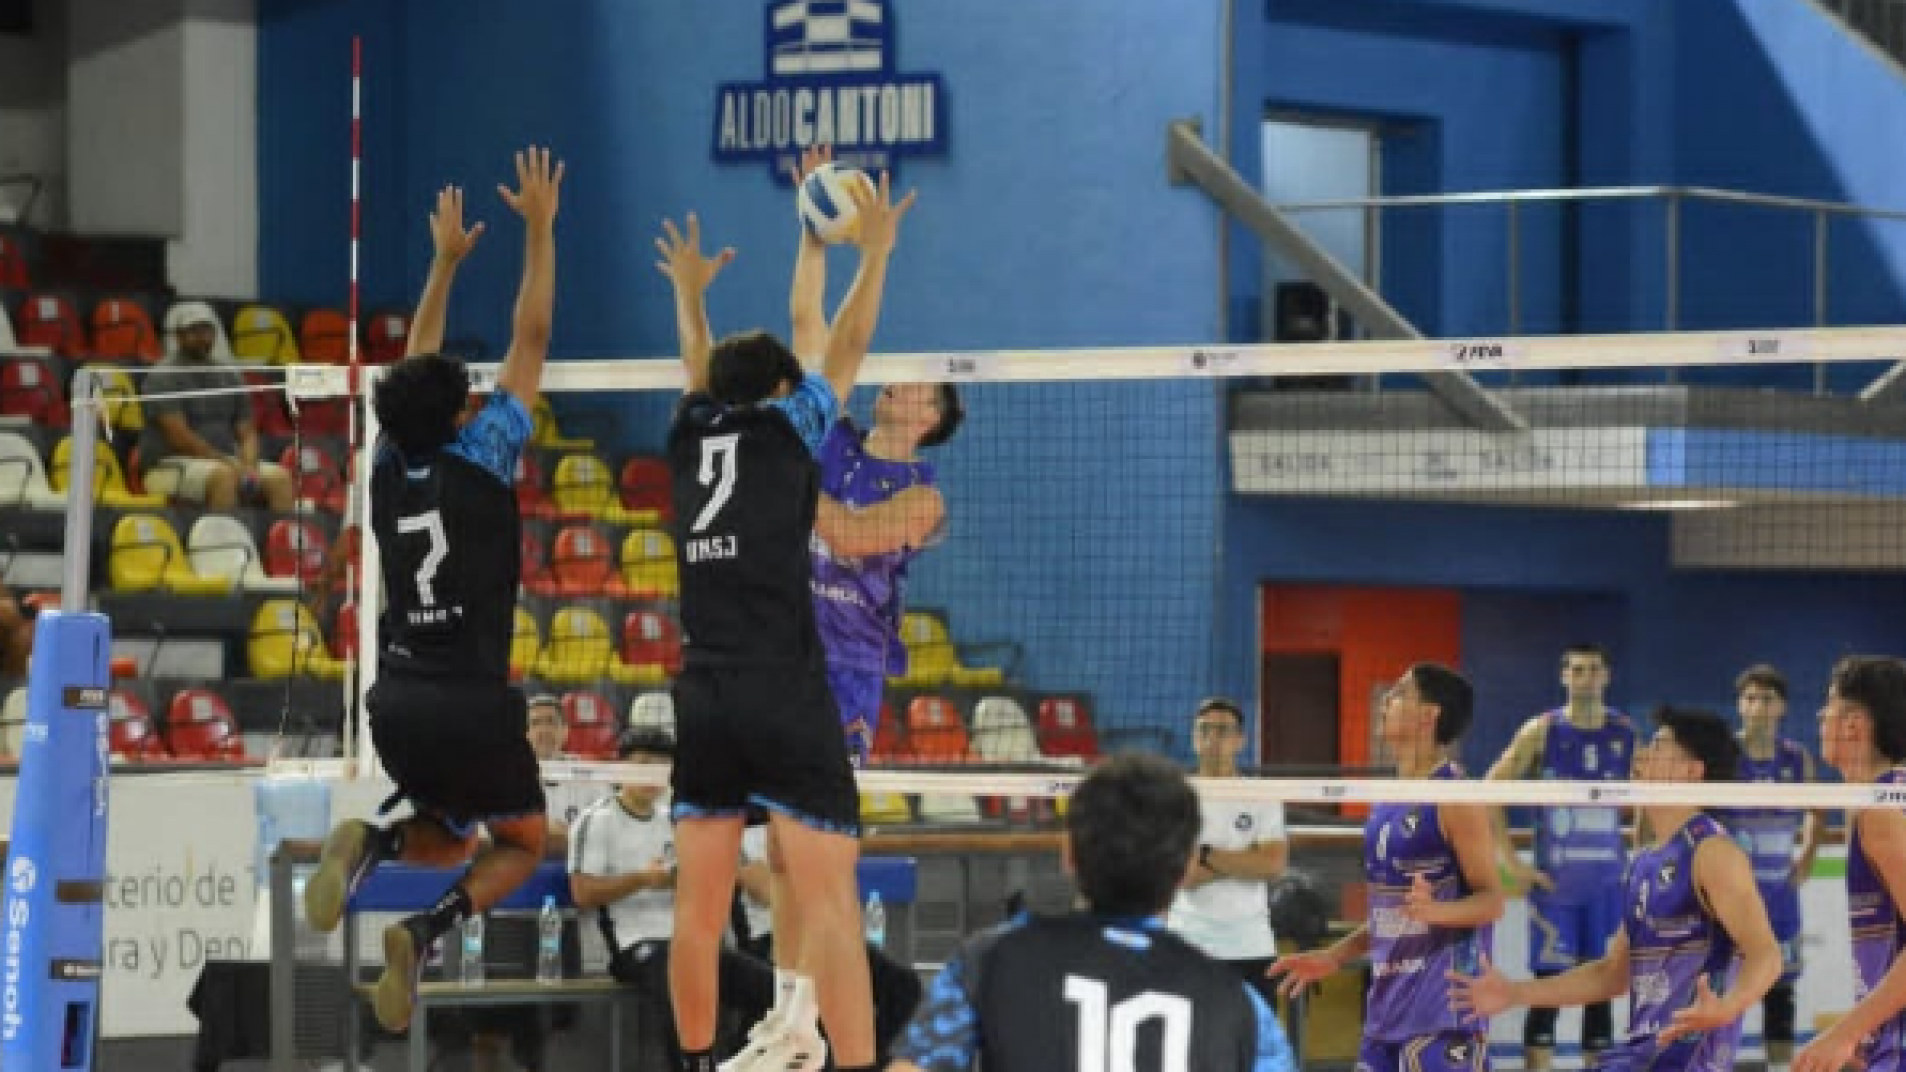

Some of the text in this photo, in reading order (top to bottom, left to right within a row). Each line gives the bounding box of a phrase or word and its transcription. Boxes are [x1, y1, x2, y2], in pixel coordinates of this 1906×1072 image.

[396, 508, 450, 607] 7
[196, 861, 235, 909] de
[150, 936, 168, 980] y
[1062, 973, 1195, 1072] 10
